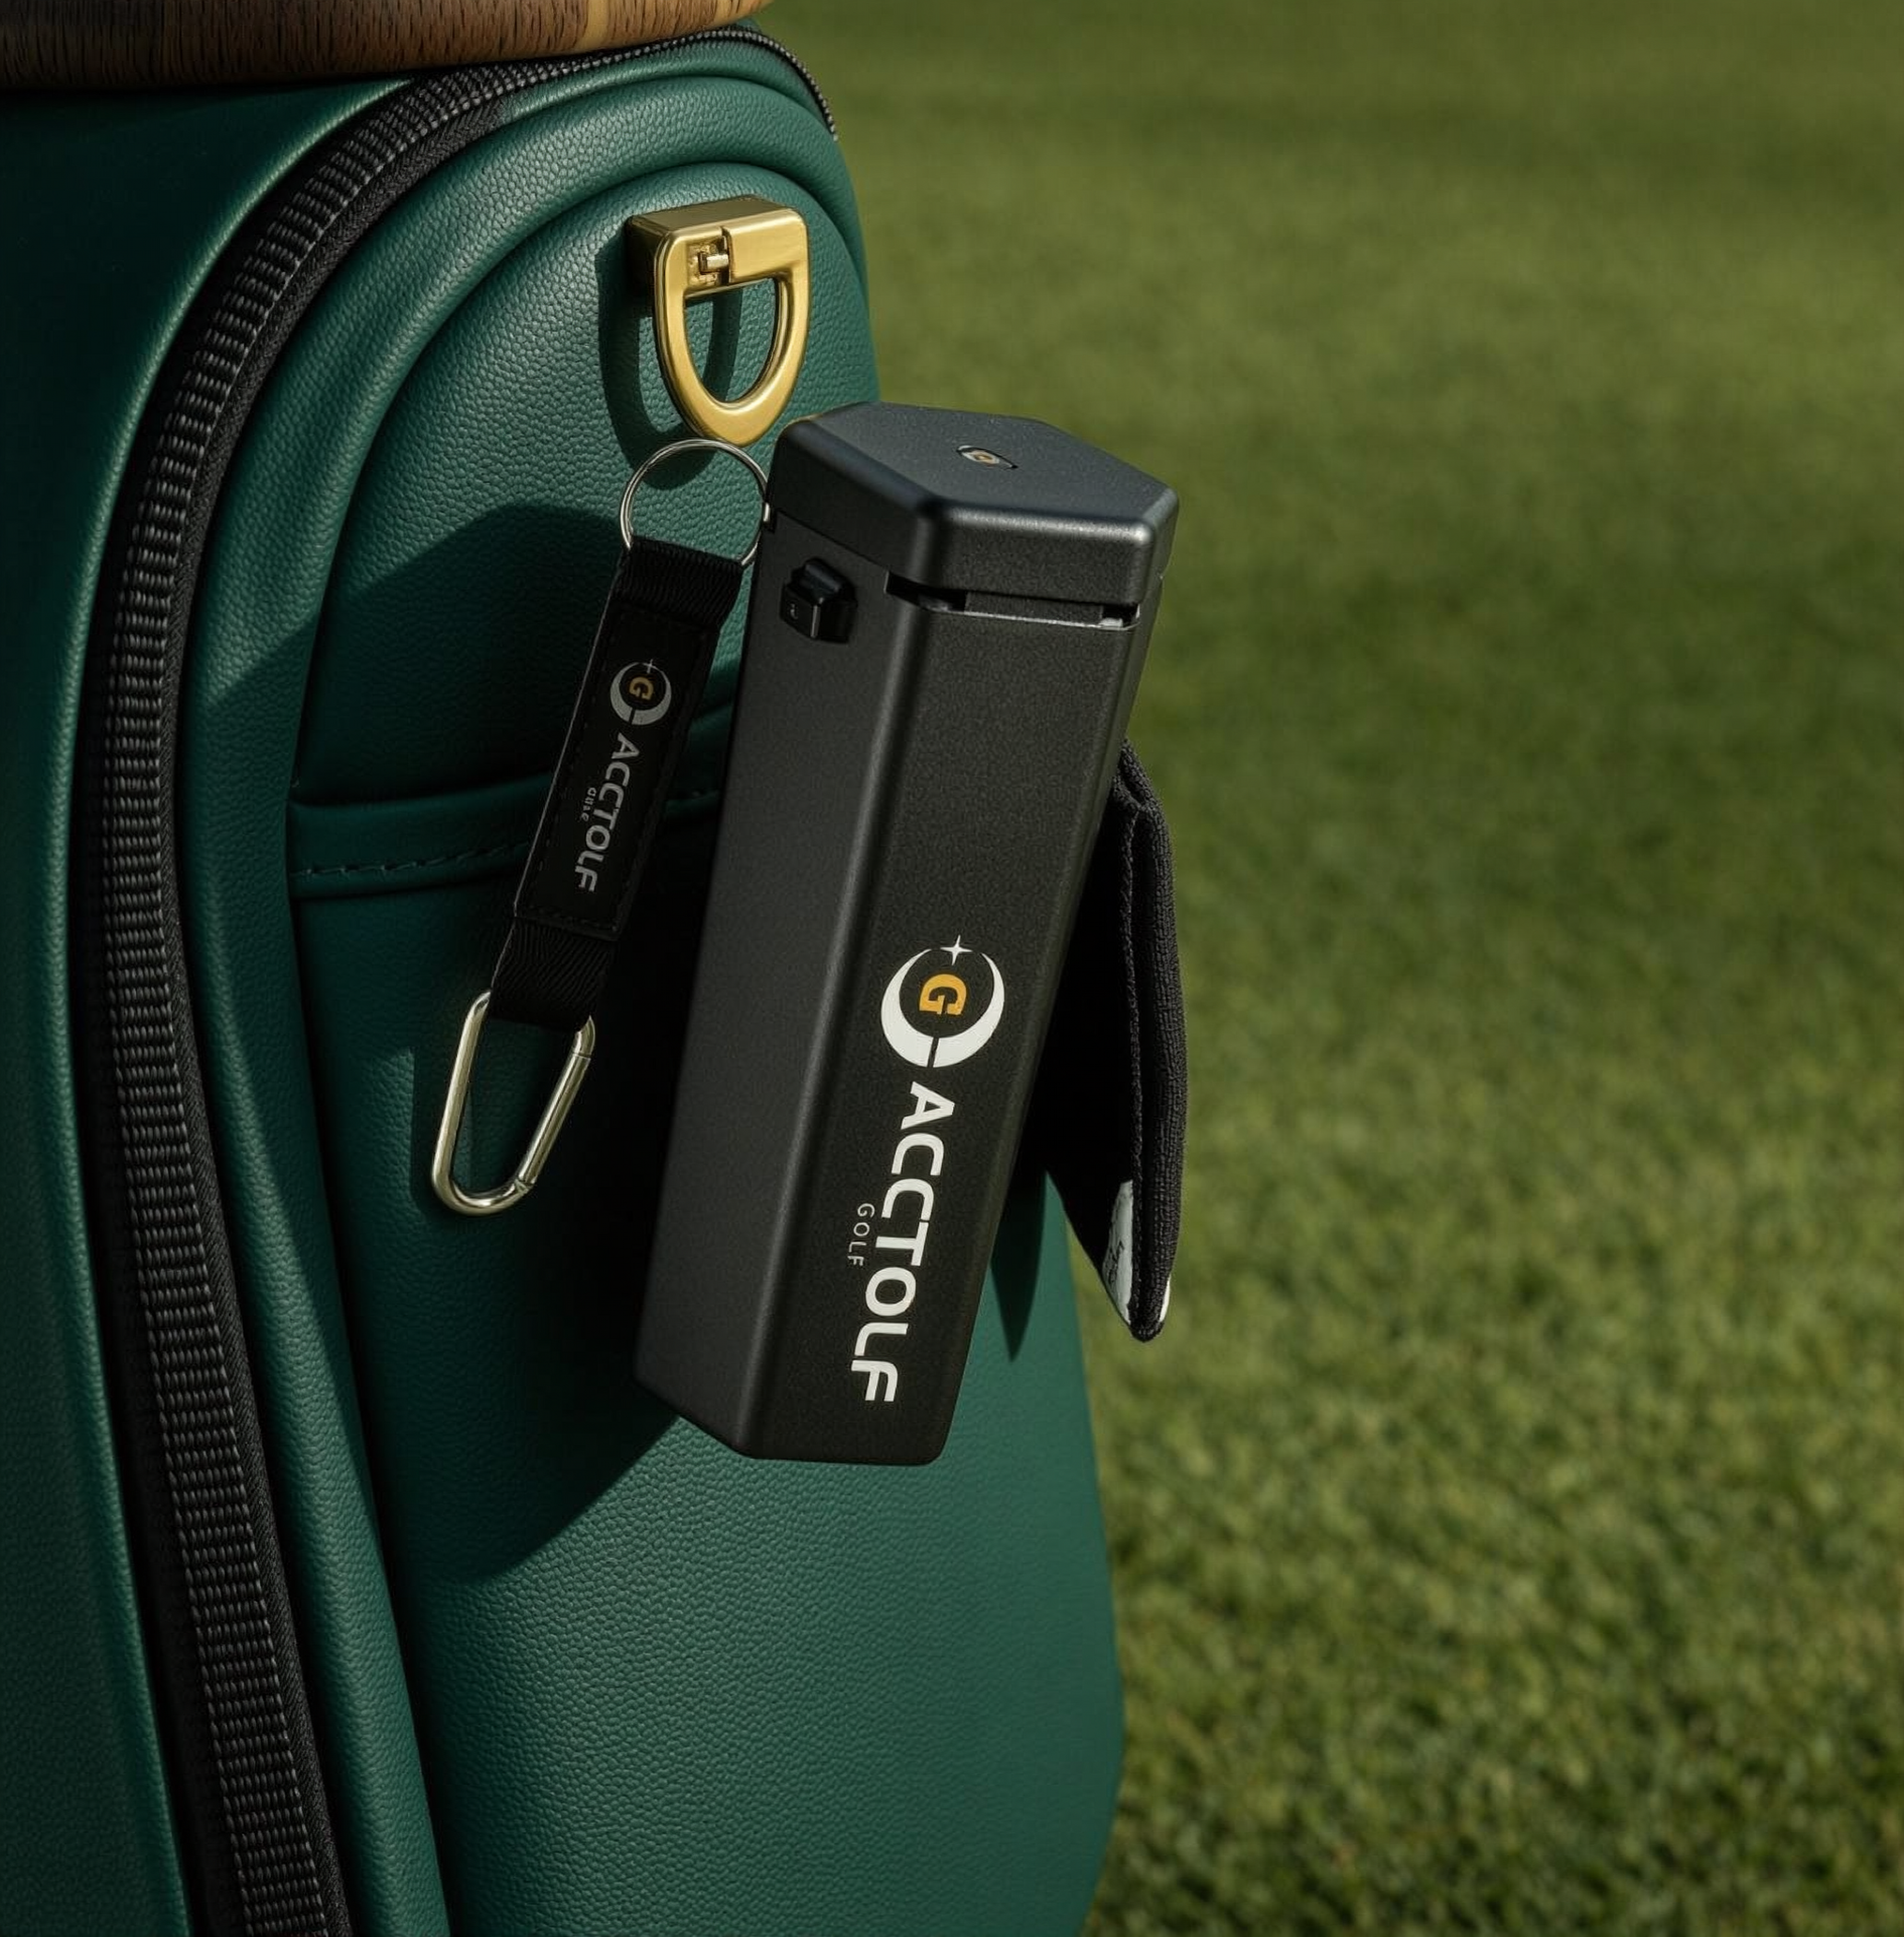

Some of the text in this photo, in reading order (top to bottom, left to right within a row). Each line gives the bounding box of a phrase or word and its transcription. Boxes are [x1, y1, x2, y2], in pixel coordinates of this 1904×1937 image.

[574, 732, 641, 892] ACCTOLF
[918, 973, 967, 1016] G
[847, 1203, 876, 1266] GOLF
[851, 1081, 956, 1402] ACCTOLF
